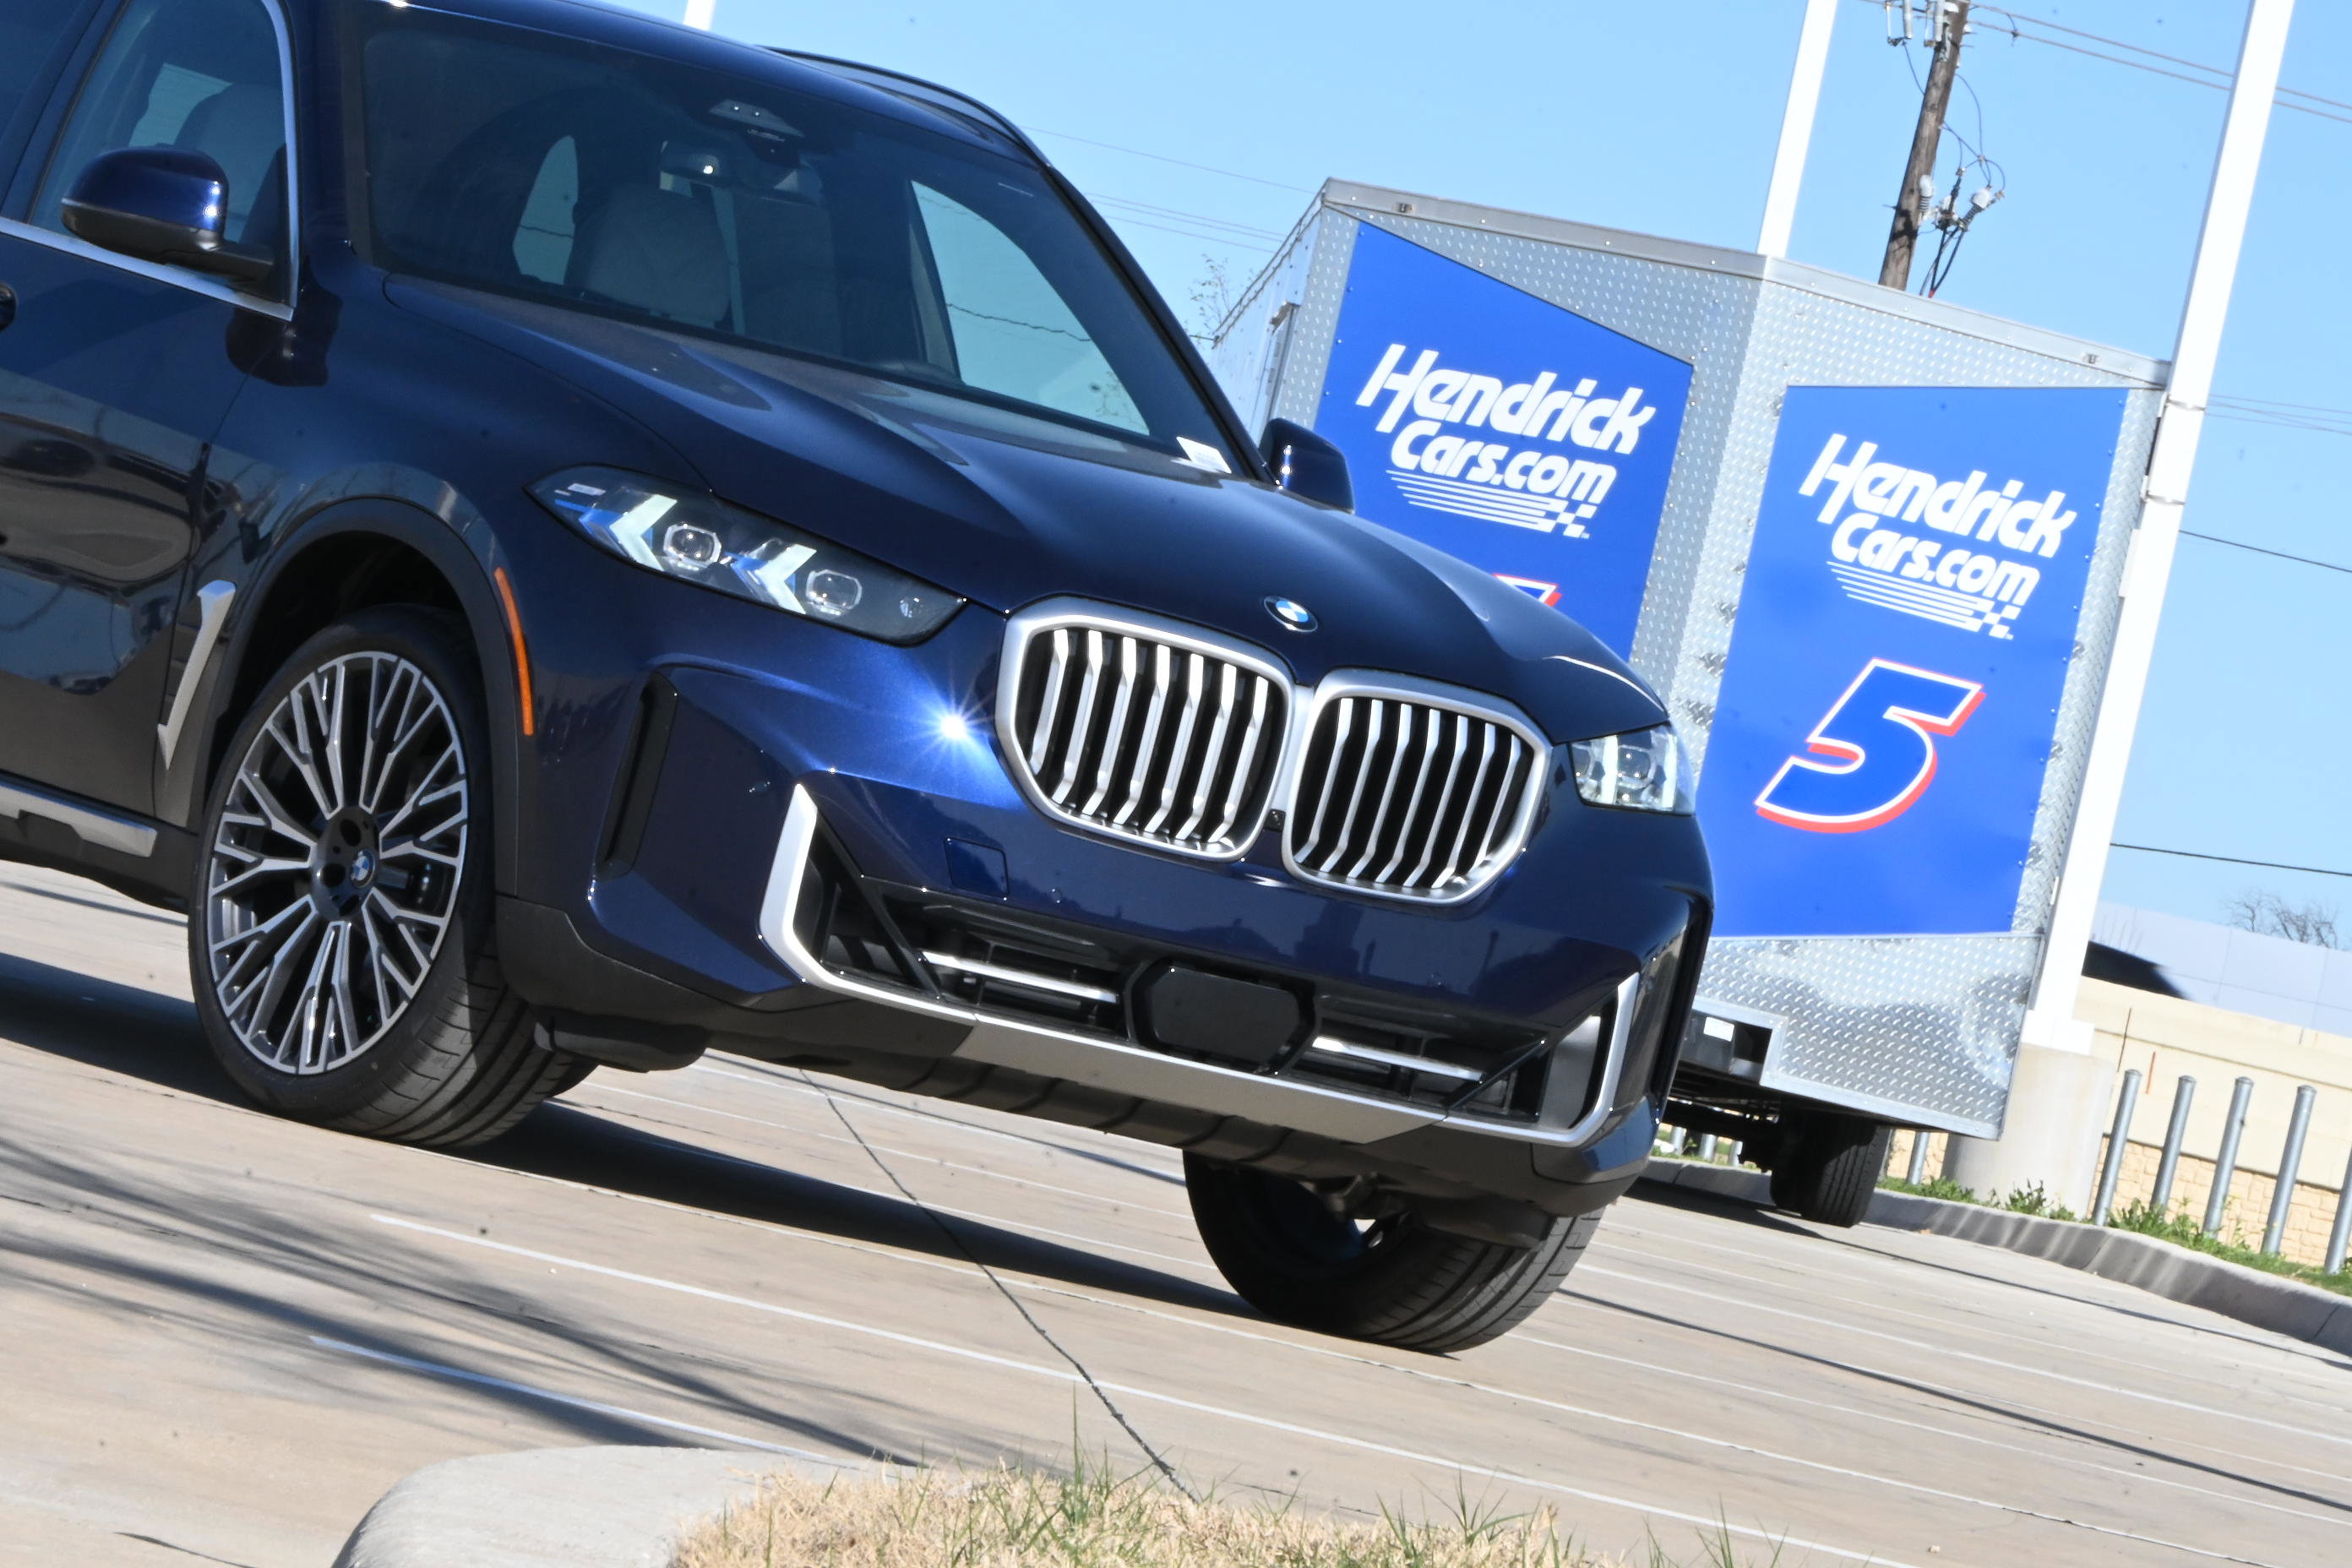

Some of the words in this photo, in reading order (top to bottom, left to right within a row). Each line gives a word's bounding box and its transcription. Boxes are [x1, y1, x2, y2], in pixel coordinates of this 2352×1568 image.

[1355, 343, 1656, 455] Hendrick
[1391, 419, 1617, 504] Cars.com
[1798, 433, 2077, 558] Hendrick
[1831, 513, 2041, 606] Cars.com
[1754, 657, 1987, 834] 5
